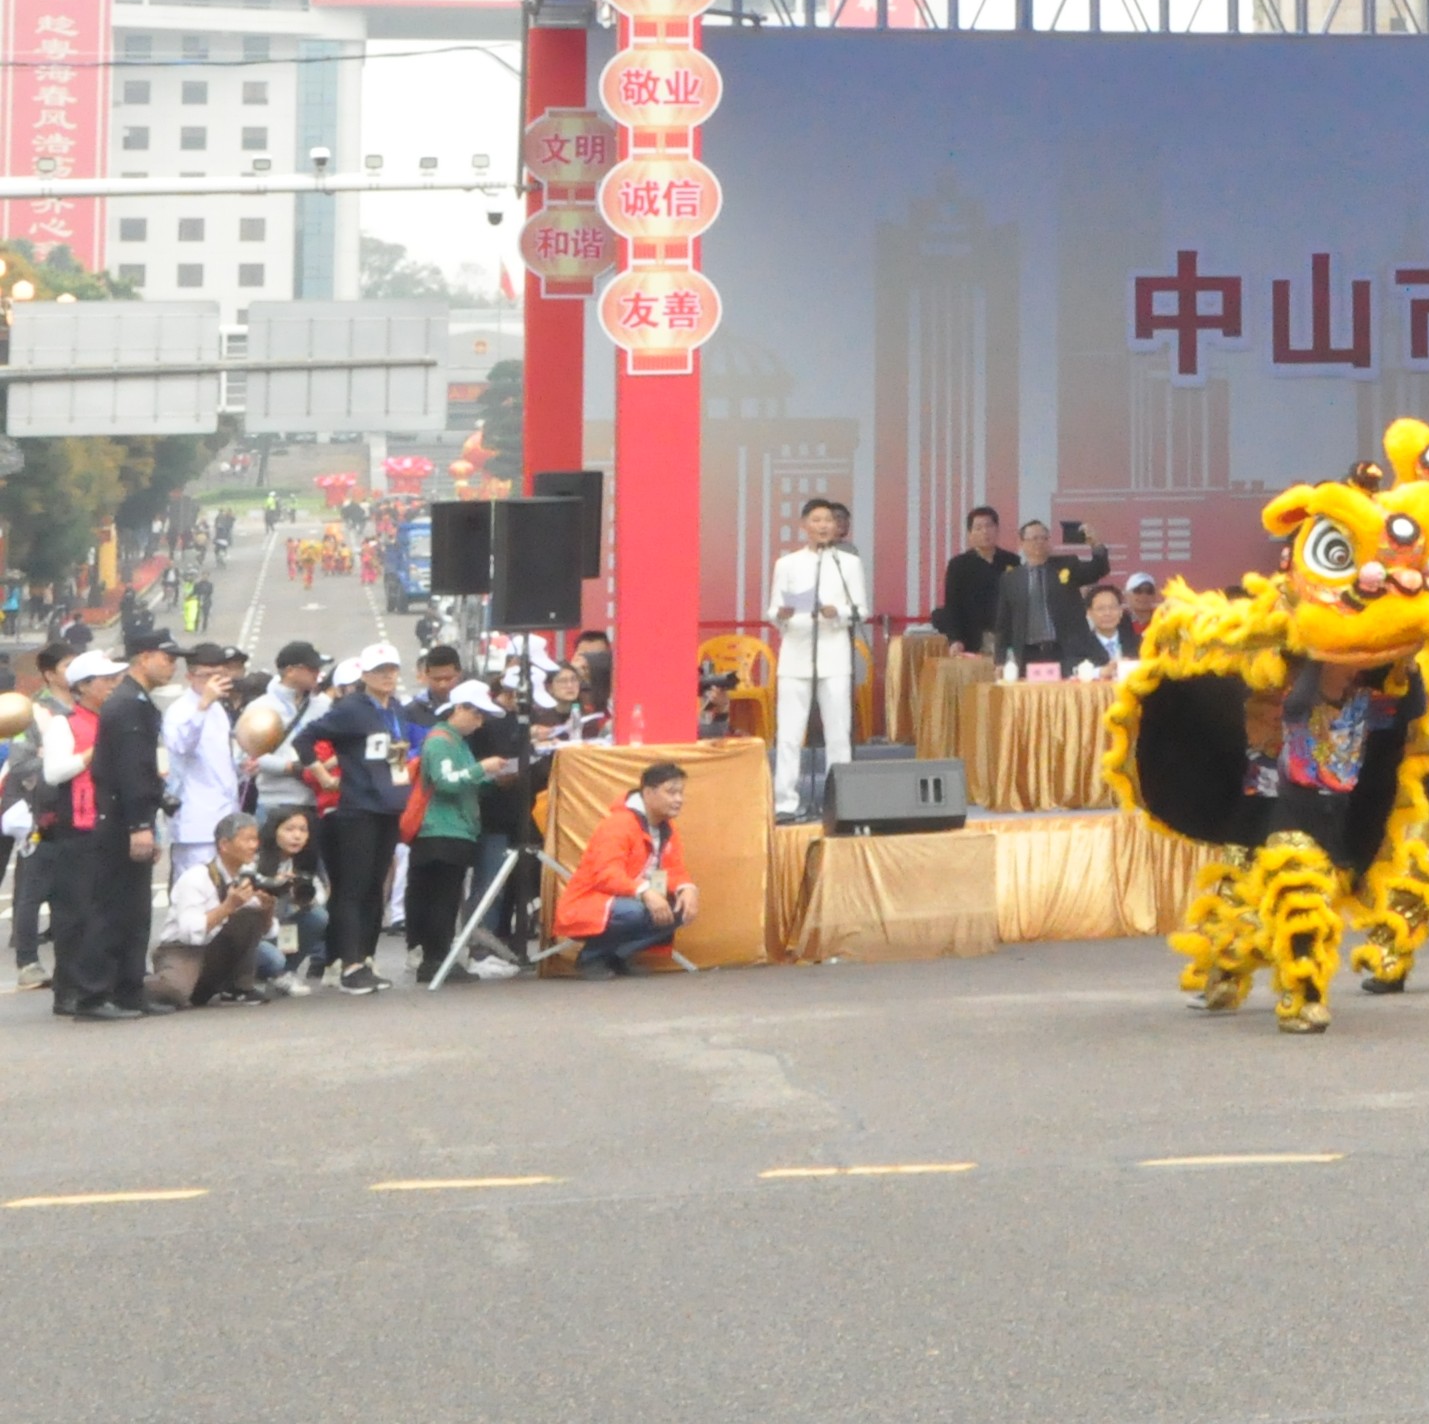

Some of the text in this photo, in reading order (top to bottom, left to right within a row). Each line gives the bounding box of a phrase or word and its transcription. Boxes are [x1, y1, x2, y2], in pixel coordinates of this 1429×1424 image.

[620, 69, 701, 106] 敬业
[541, 133, 606, 165] 文明
[620, 180, 701, 218] 诚信
[536, 227, 604, 260] 和谐
[620, 292, 701, 330] 友善
